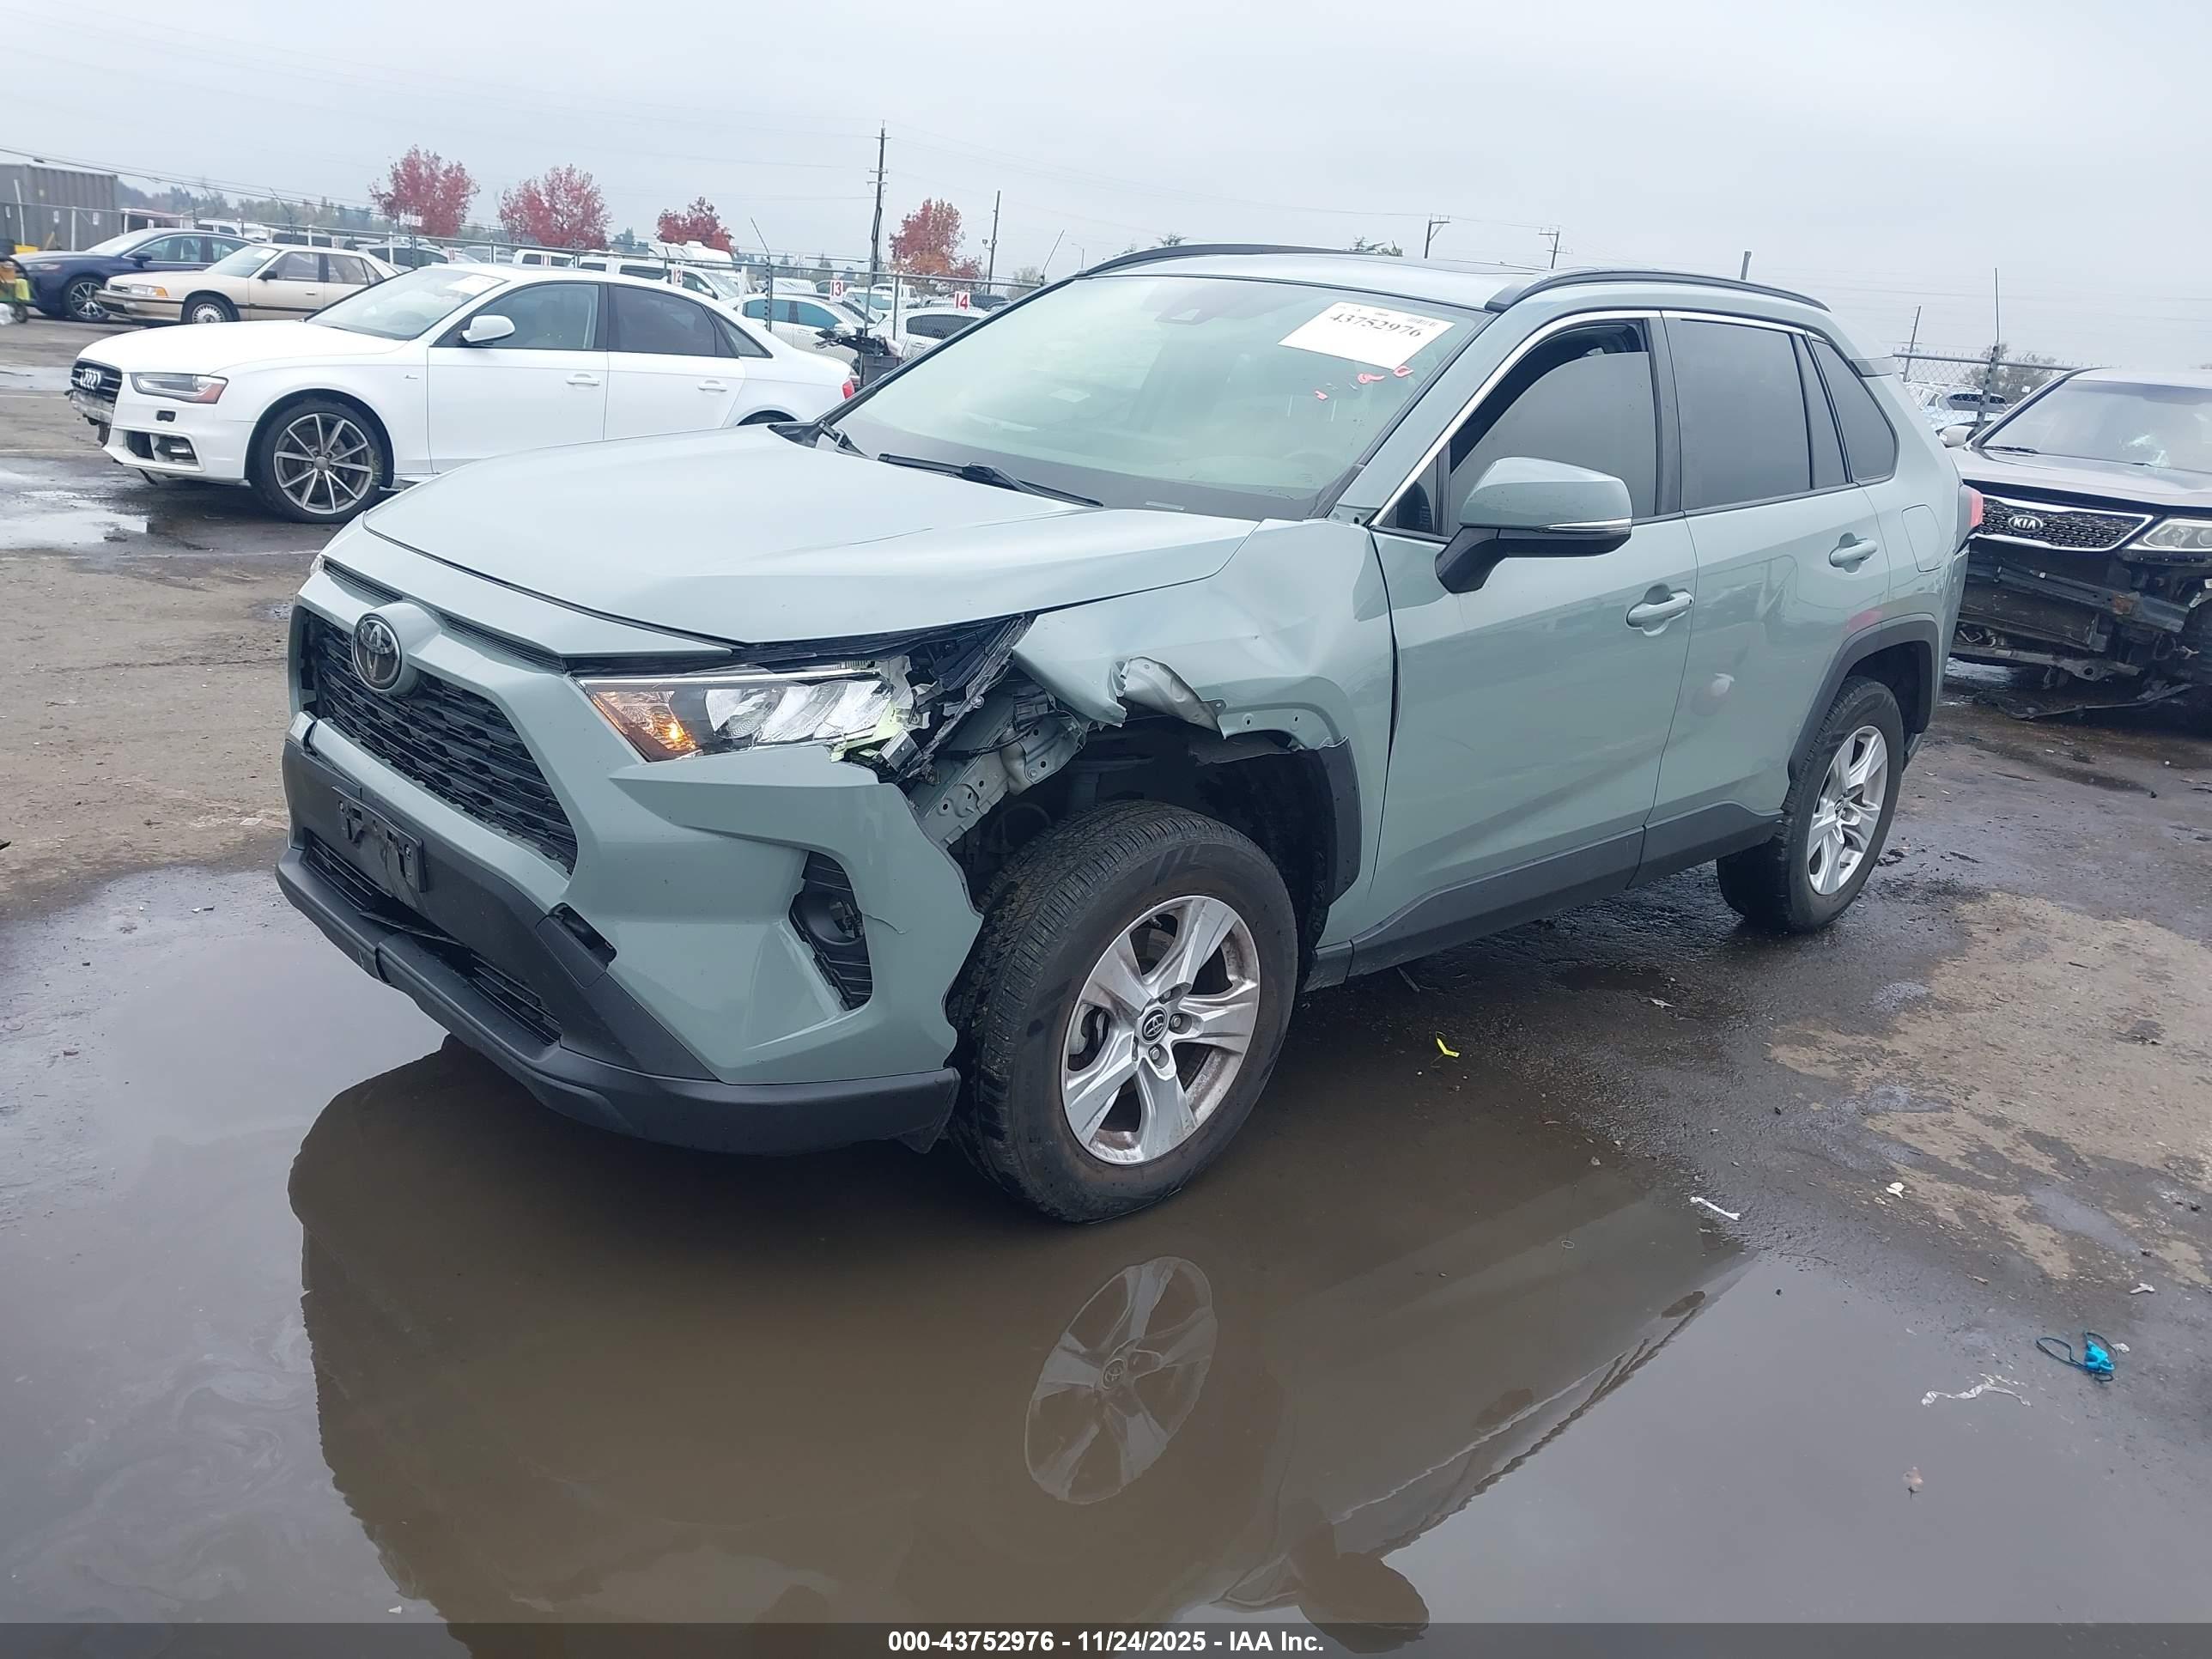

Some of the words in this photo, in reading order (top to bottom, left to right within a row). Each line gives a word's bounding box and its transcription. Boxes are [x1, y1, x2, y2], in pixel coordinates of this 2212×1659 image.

[673, 269, 681, 283] 12
[831, 282, 842, 296] 13
[956, 294, 969, 310] 14
[1329, 313, 1422, 337] 43752976
[2013, 516, 2036, 529] KIA
